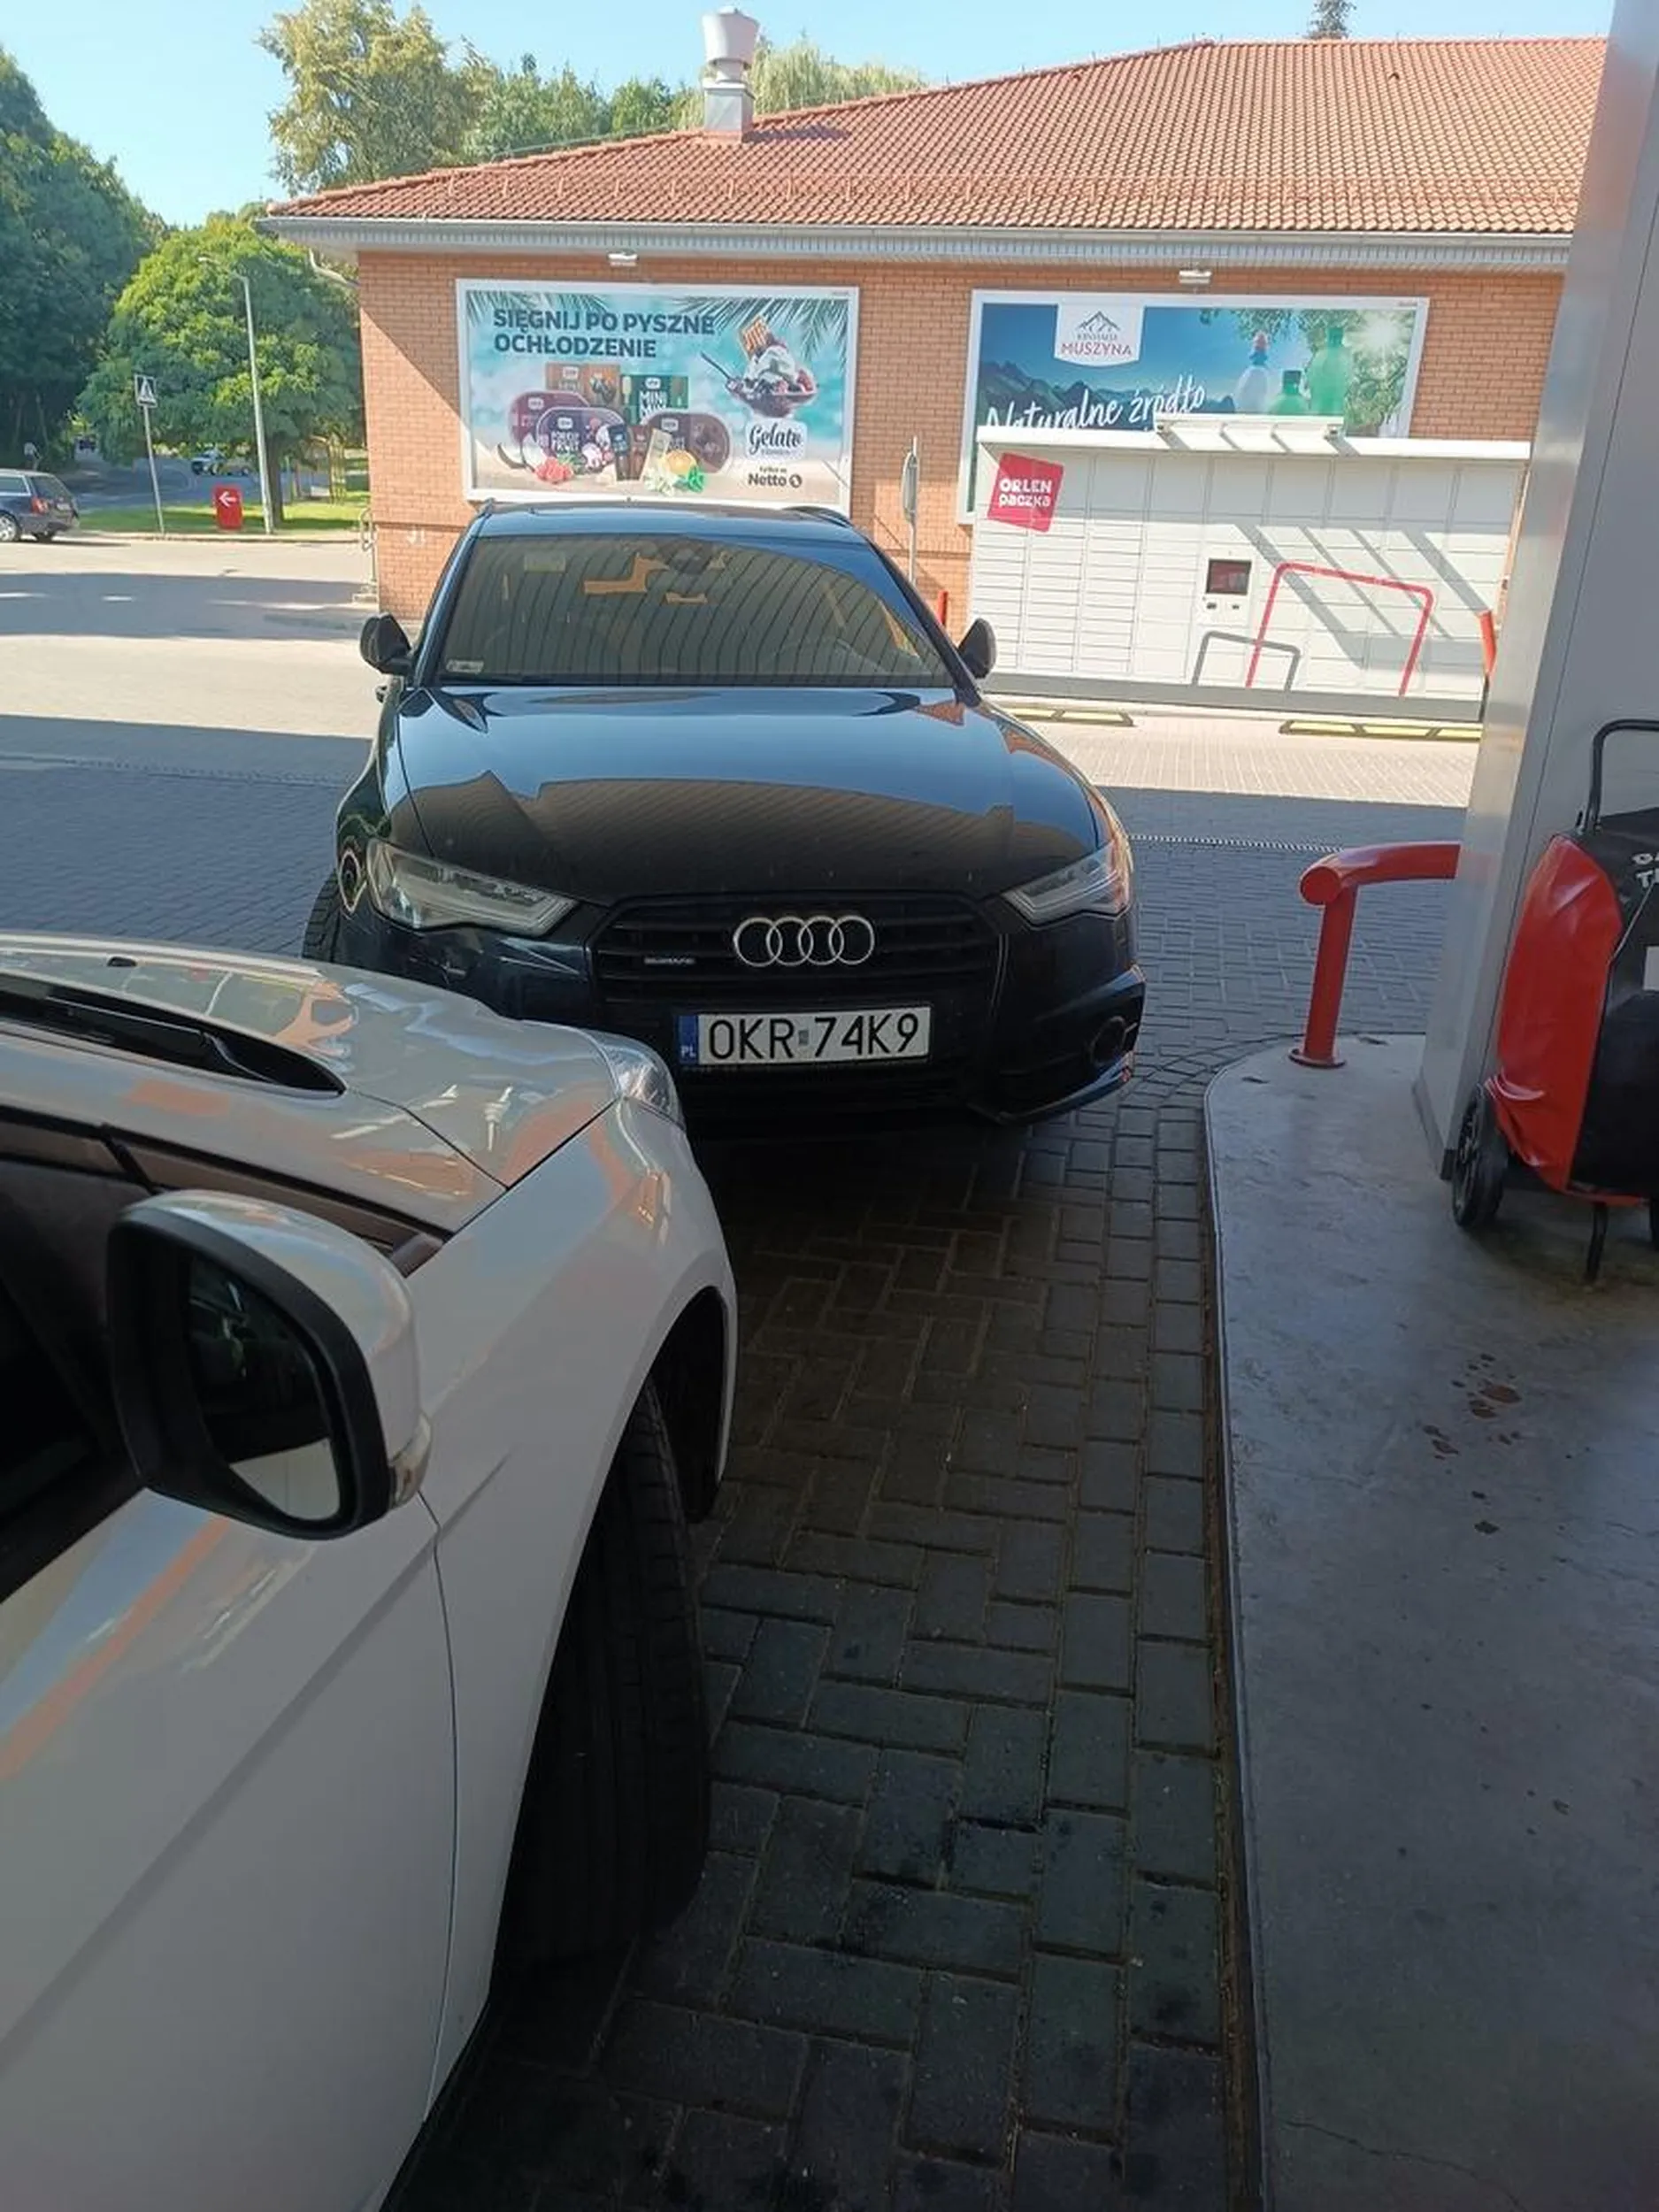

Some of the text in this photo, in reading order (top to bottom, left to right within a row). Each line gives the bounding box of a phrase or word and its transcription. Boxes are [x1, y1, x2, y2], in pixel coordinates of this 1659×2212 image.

[493, 310, 716, 334] SIĘGNIJ PO PYSZNE
[494, 333, 657, 357] OCHŁODZENIE
[1061, 342, 1133, 356] MUSZYNA
[986, 389, 1124, 429] Naturalne
[748, 422, 803, 455] Gelato
[748, 472, 787, 487] Netto
[999, 478, 1052, 494] ORLEN
[998, 493, 1052, 507] paczka
[709, 1013, 919, 1059] OKR 74K9
[680, 1046, 696, 1057] PL
